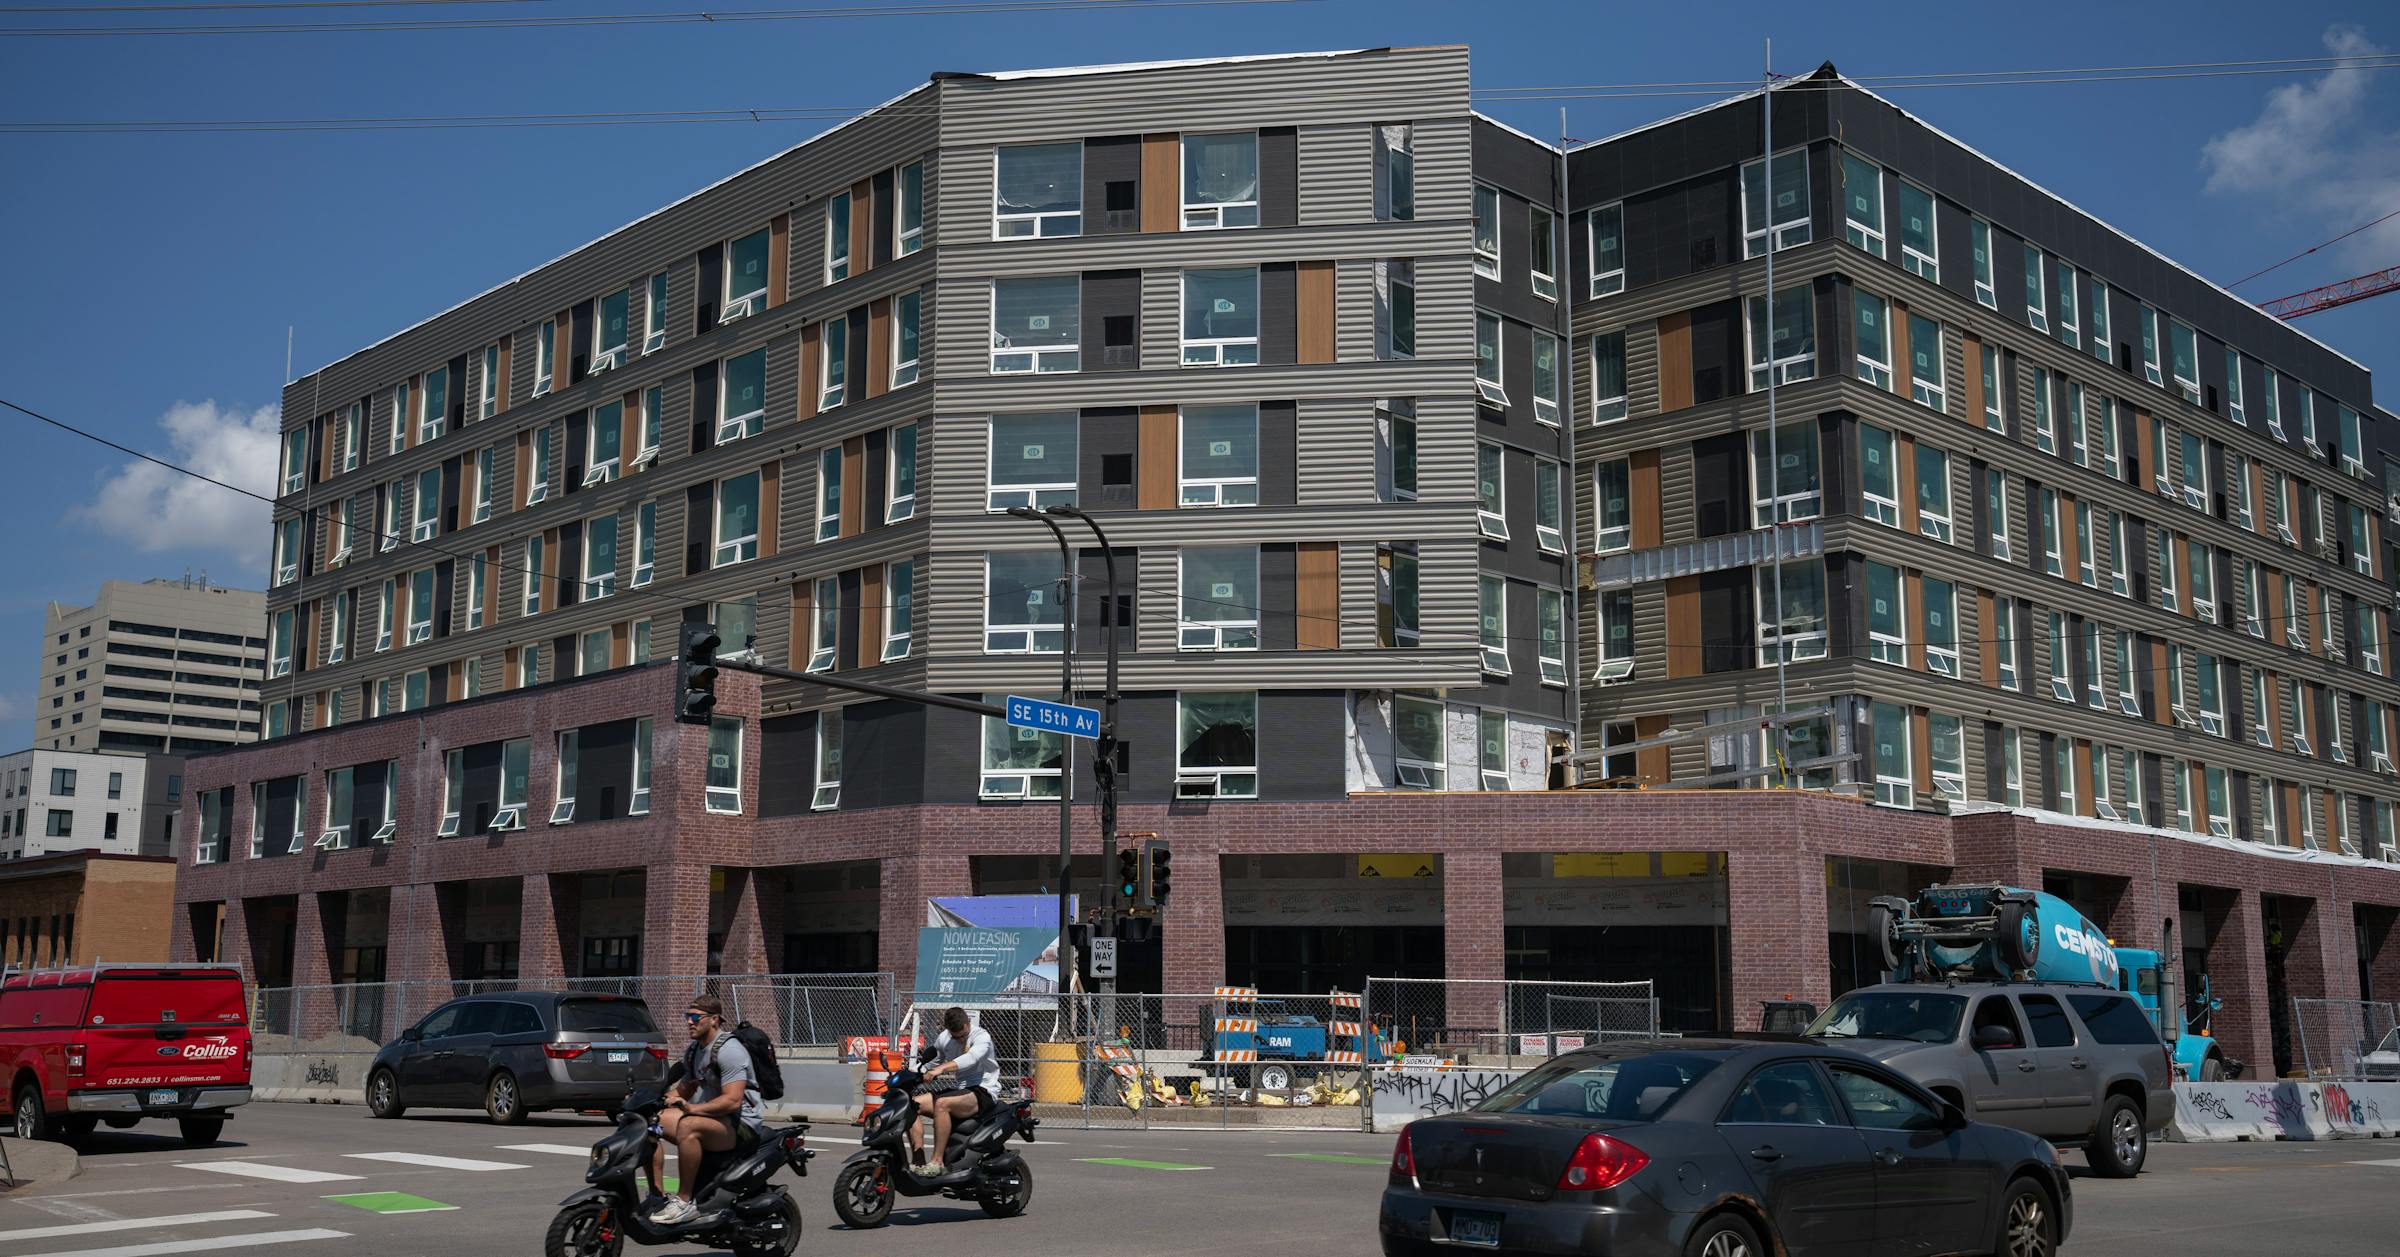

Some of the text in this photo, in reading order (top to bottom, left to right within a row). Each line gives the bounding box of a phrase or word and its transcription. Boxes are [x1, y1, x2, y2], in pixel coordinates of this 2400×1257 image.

[1013, 703, 1093, 730] SE 15th Av
[943, 932, 1020, 945] NOW LEASING
[1095, 940, 1113, 950] ONE
[2054, 924, 2119, 974] CEMSTO
[1094, 951, 1113, 961] WAY
[1269, 1037, 1291, 1047] RAM
[183, 1044, 238, 1058] Collins
[106, 1076, 161, 1085] 651.224.2833
[170, 1075, 221, 1083] collinsmn.com
